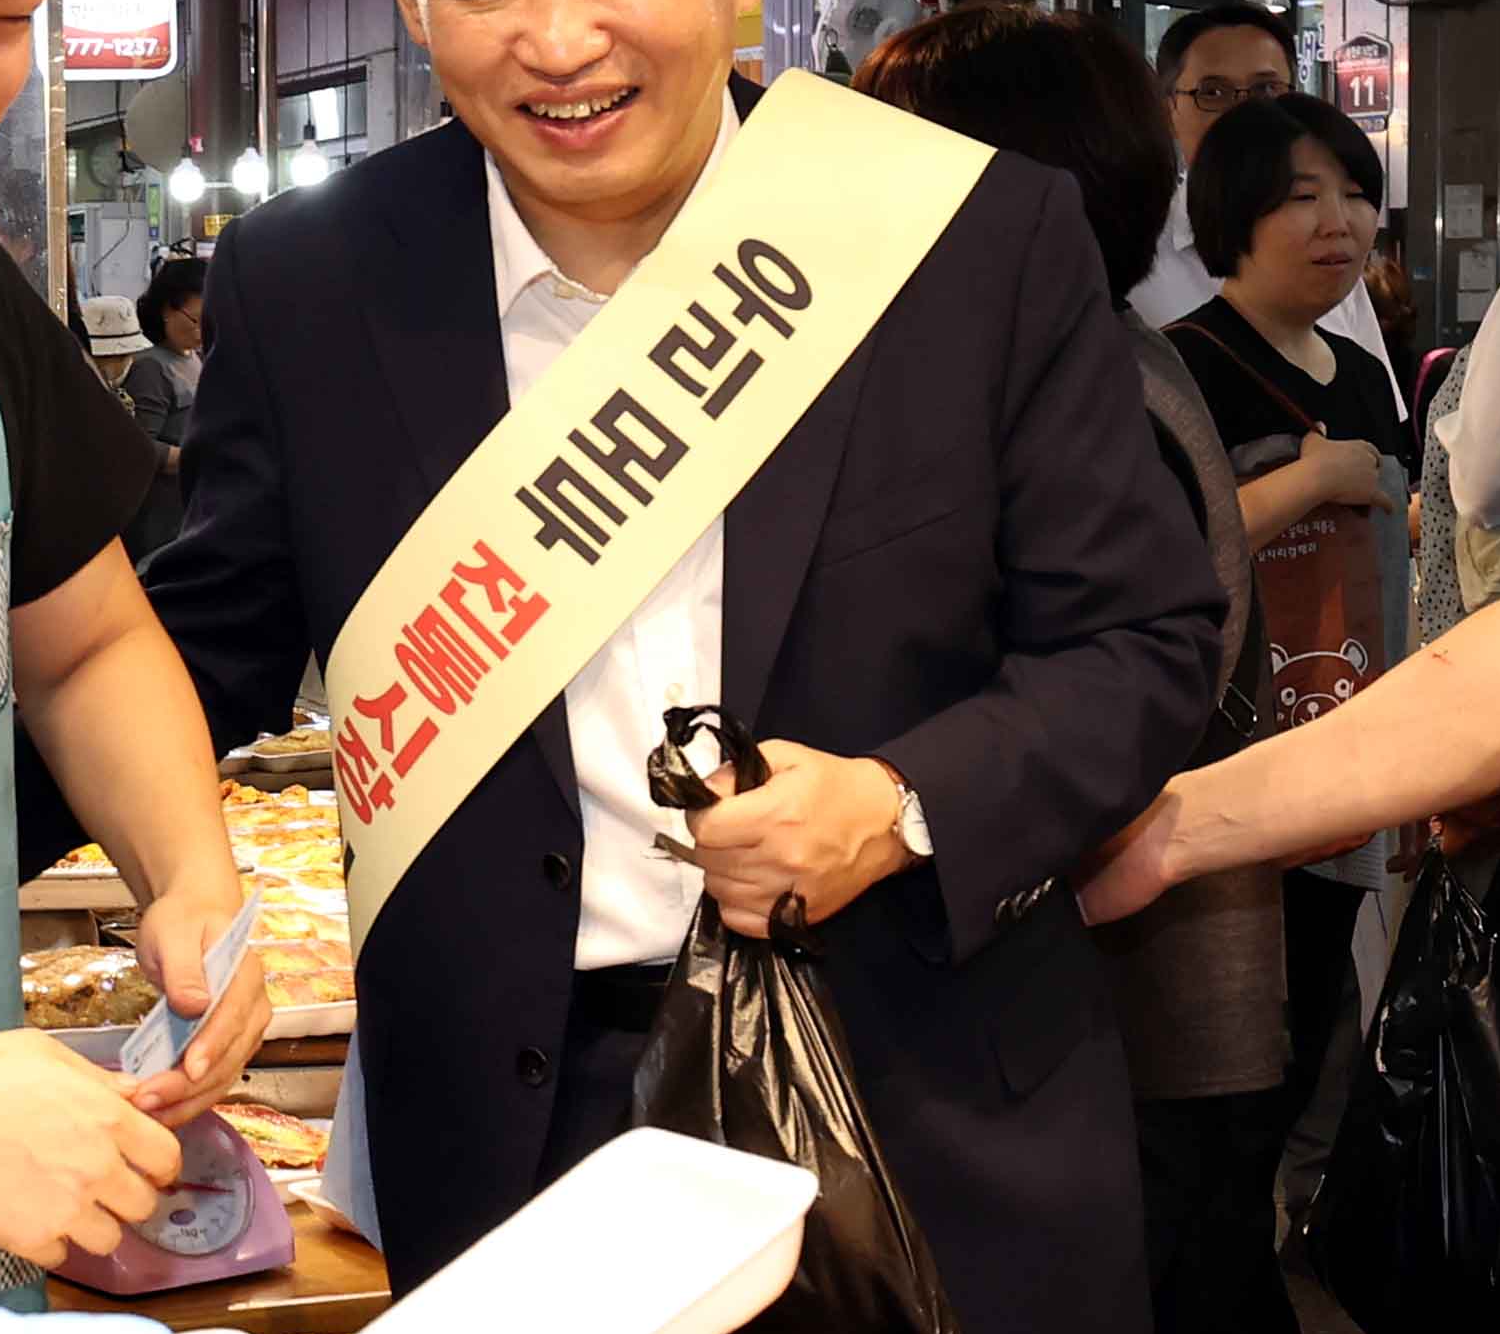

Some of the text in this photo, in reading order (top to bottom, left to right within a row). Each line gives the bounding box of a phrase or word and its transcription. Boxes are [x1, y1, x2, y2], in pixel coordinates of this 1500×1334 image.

[63, 37, 159, 57] 777-1237
[1349, 75, 1375, 107] 11
[341, 237, 813, 826] 우리 모두 전통시장
